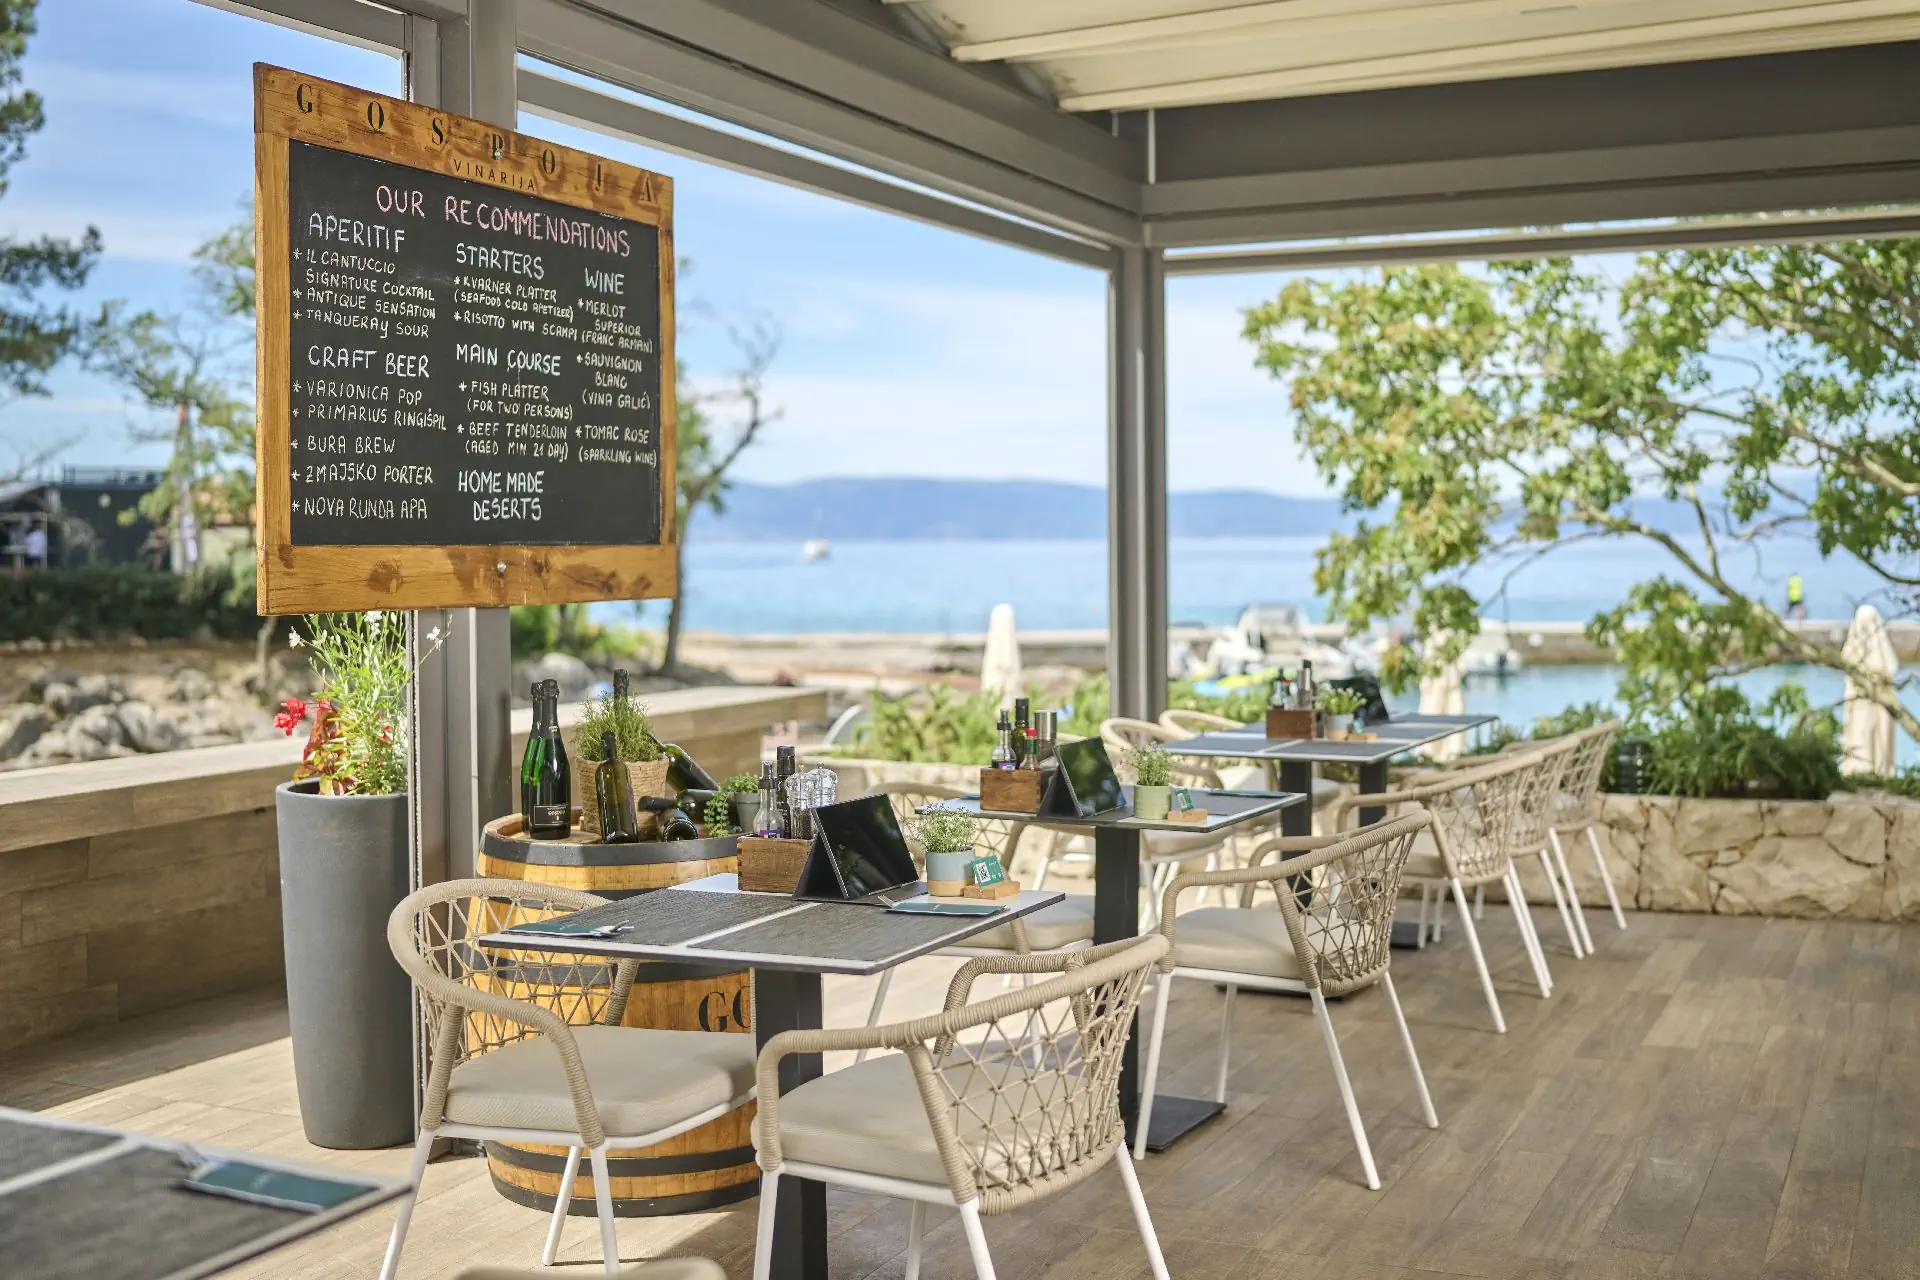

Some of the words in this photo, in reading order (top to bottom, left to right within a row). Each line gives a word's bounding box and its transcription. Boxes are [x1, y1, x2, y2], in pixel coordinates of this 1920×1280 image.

[454, 159, 536, 191] VINARIJA
[309, 212, 405, 252] APERITIF
[376, 186, 425, 218] OUR
[445, 196, 630, 257] RECOMMENDATIONS
[306, 248, 316, 264] IL
[322, 250, 396, 274] CANTUCCIO
[456, 242, 544, 280] STARTERS
[306, 268, 377, 292] SIGNATURE
[383, 282, 435, 300] COCKTAIL
[464, 276, 512, 294] KVARNER
[516, 284, 556, 302] PLATTER
[584, 268, 625, 295] WINE
[307, 286, 366, 310] ANTIQUE
[376, 300, 436, 320] SENSATION
[454, 290, 501, 307] (SEAFOOD
[505, 299, 528, 312] COLD
[586, 300, 626, 318] MERLOT
[396, 322, 428, 338] SOUR
[464, 310, 504, 329] RISOTTO
[512, 319, 534, 332] WITH
[542, 322, 578, 341] SCAMPI
[594, 319, 641, 336] SUPERIOR
[582, 330, 614, 346] (FRANC
[618, 337, 652, 353] ARMAN)
[308, 345, 378, 368] CRAFT
[386, 352, 430, 378] BEER
[456, 344, 498, 366] MAIN
[506, 349, 561, 376] COURSE
[584, 354, 642, 373] SAUVIGNON
[306, 380, 388, 402] VARIONICA
[398, 388, 422, 405] POP
[471, 380, 497, 396] FISH
[502, 382, 550, 402] PLATTER
[582, 388, 612, 406] (VINA
[308, 404, 388, 424] PRIMARIUS
[467, 398, 493, 414] (FOR
[498, 401, 519, 415] TWO
[524, 404, 573, 421] PERSONS)
[470, 422, 500, 436] BEEF
[506, 422, 567, 440] TENDERLOIN
[584, 424, 619, 441] TOMAC
[624, 428, 650, 444] ROSE
[308, 436, 346, 454] BURA
[356, 436, 396, 454] BREW
[466, 440, 499, 455] (AGED
[508, 442, 526, 456] MIN
[533, 444, 544, 457] 21
[578, 446, 632, 464] (SPARKLING
[635, 451, 657, 468] WINE)
[384, 466, 433, 485] PORTER
[458, 470, 502, 493] HOME
[506, 470, 544, 493] MADE
[304, 496, 344, 517] NOVA
[350, 498, 394, 519] RUNDA
[400, 498, 428, 520] APA
[474, 497, 542, 522] DESERTS
